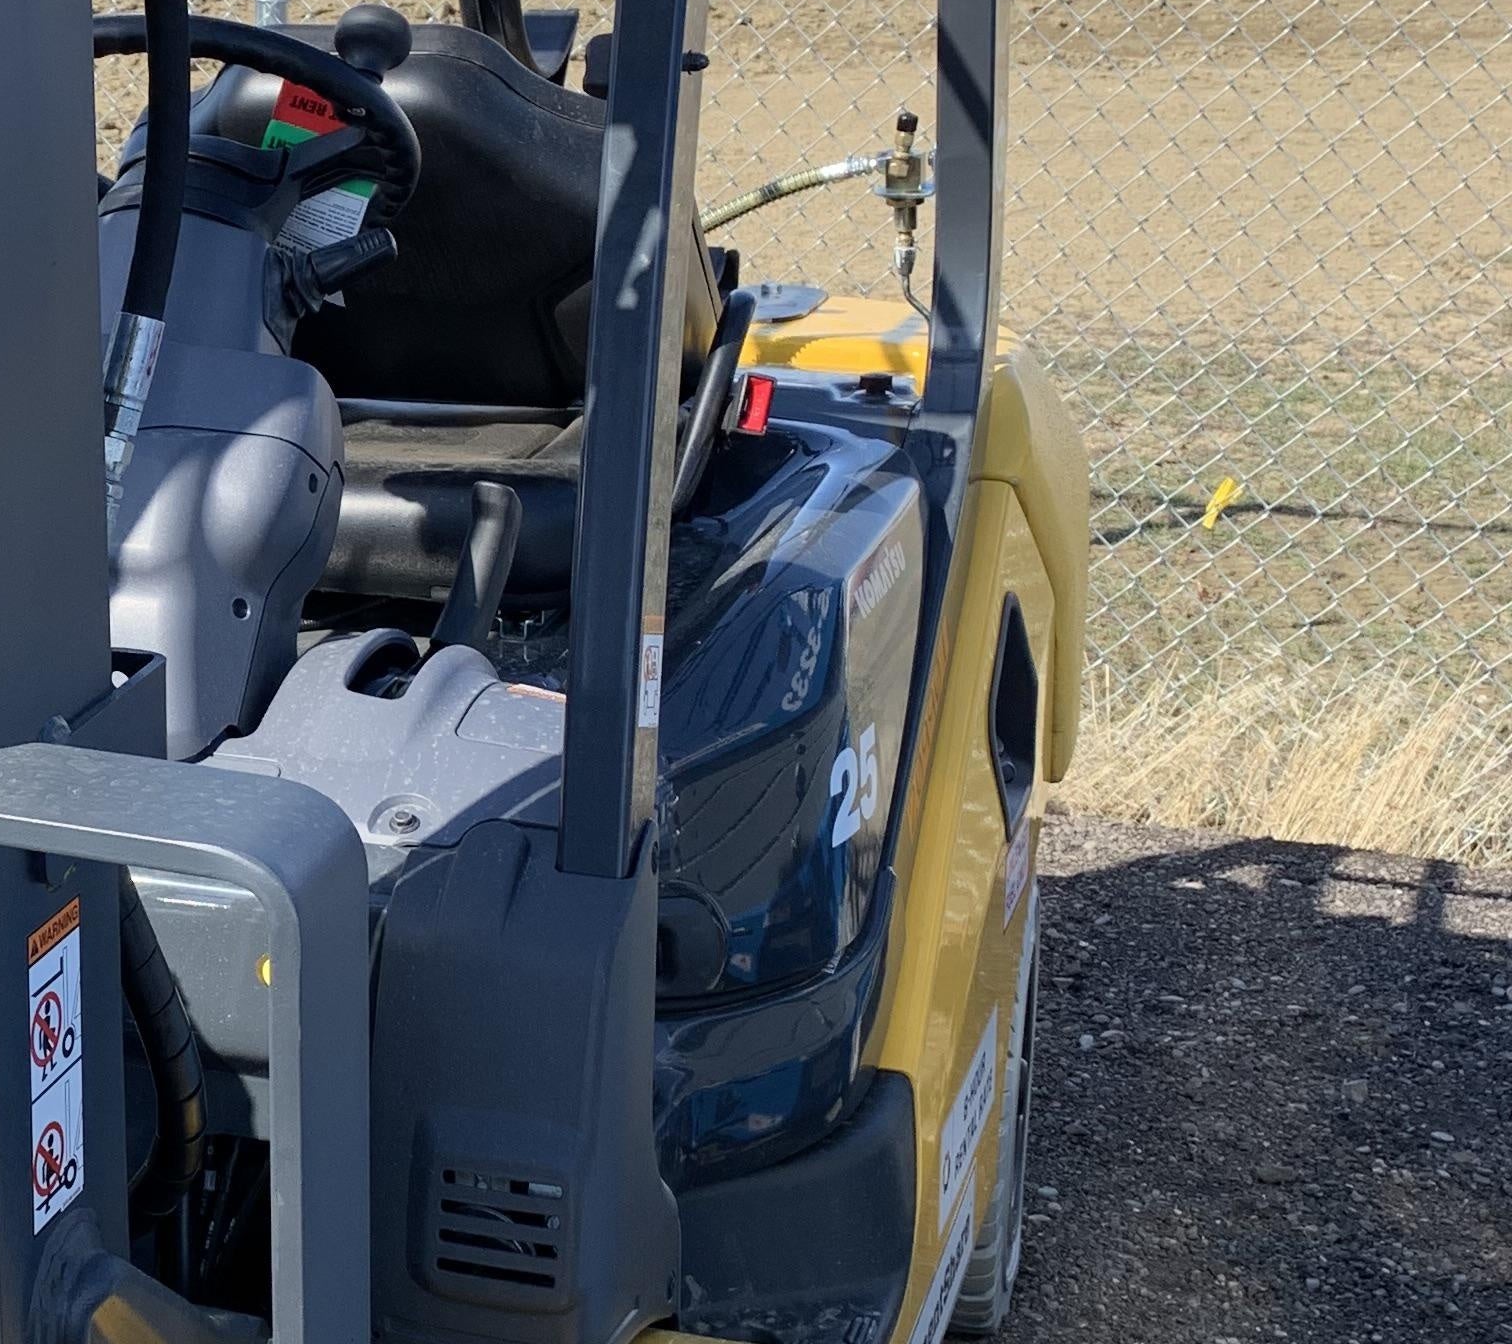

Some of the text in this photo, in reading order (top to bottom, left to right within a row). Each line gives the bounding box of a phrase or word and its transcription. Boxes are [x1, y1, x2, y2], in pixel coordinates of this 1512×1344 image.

[289, 96, 328, 117] RENT
[854, 541, 906, 620] KOMATSU
[830, 721, 878, 849] 25
[37, 904, 78, 949] WARNING
